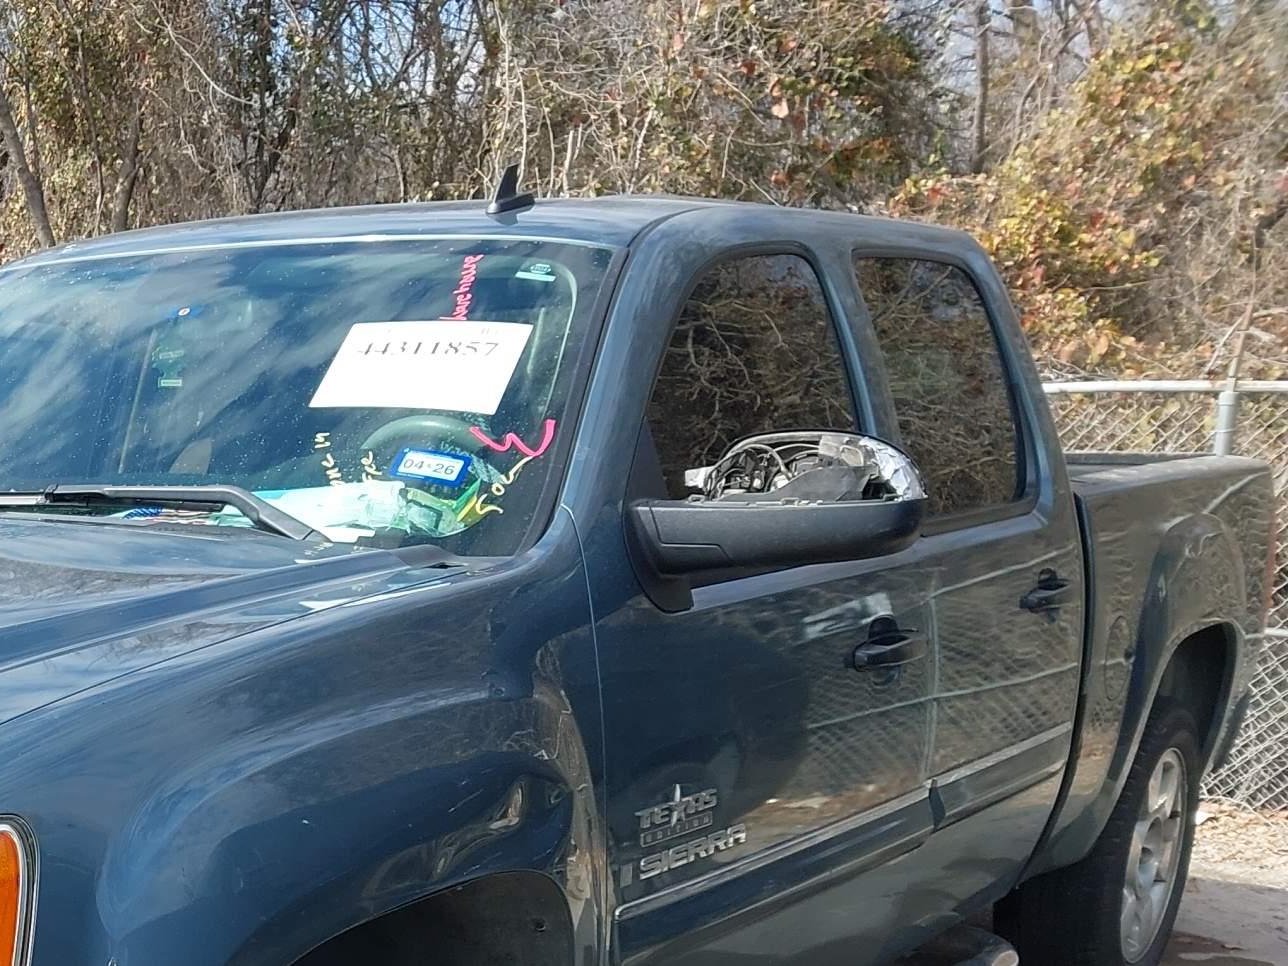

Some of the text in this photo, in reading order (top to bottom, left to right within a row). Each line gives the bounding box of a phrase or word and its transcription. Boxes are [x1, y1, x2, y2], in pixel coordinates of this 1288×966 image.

[357, 340, 500, 357] 44311857
[634, 785, 718, 829] TEXAS
[644, 814, 712, 845] EDITION
[639, 823, 747, 881] SIERRA
